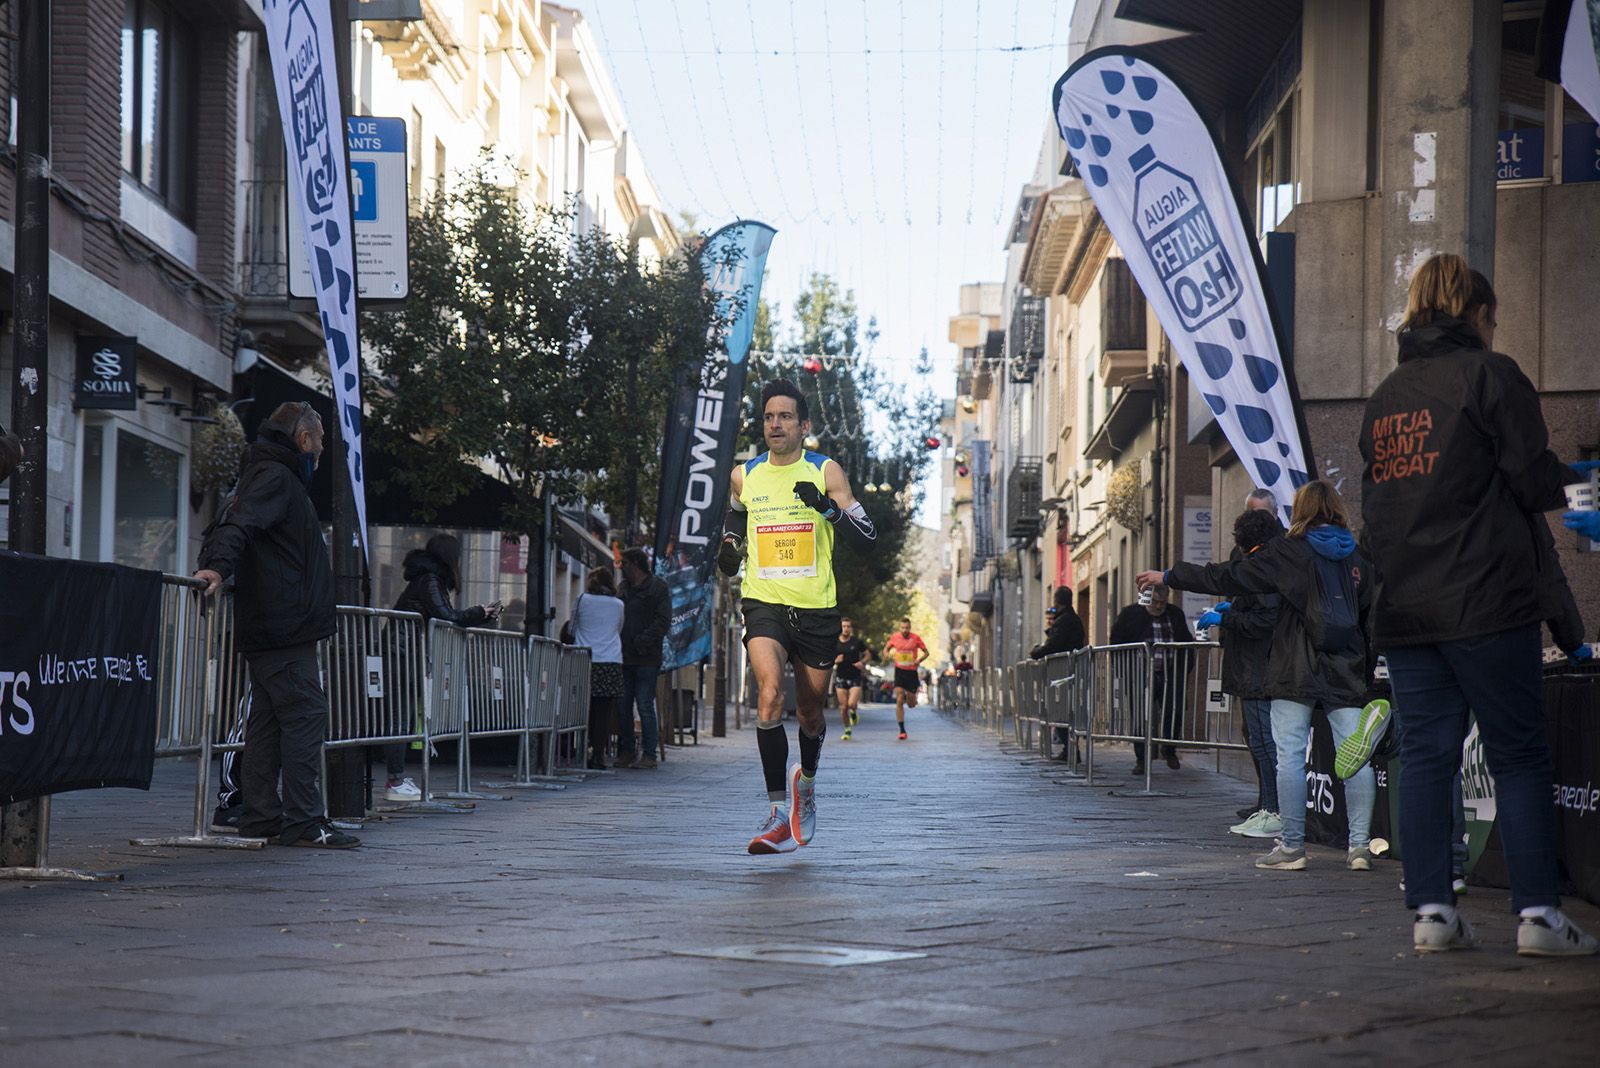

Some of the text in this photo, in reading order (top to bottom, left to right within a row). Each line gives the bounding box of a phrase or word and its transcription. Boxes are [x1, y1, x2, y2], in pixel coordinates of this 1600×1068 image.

[358, 123, 377, 134] DE
[1373, 408, 1432, 440] MITJA
[1375, 431, 1429, 461] SANT
[1372, 451, 1440, 485] CUGAT
[774, 538, 796, 548] SERGIO
[779, 549, 794, 560] 548
